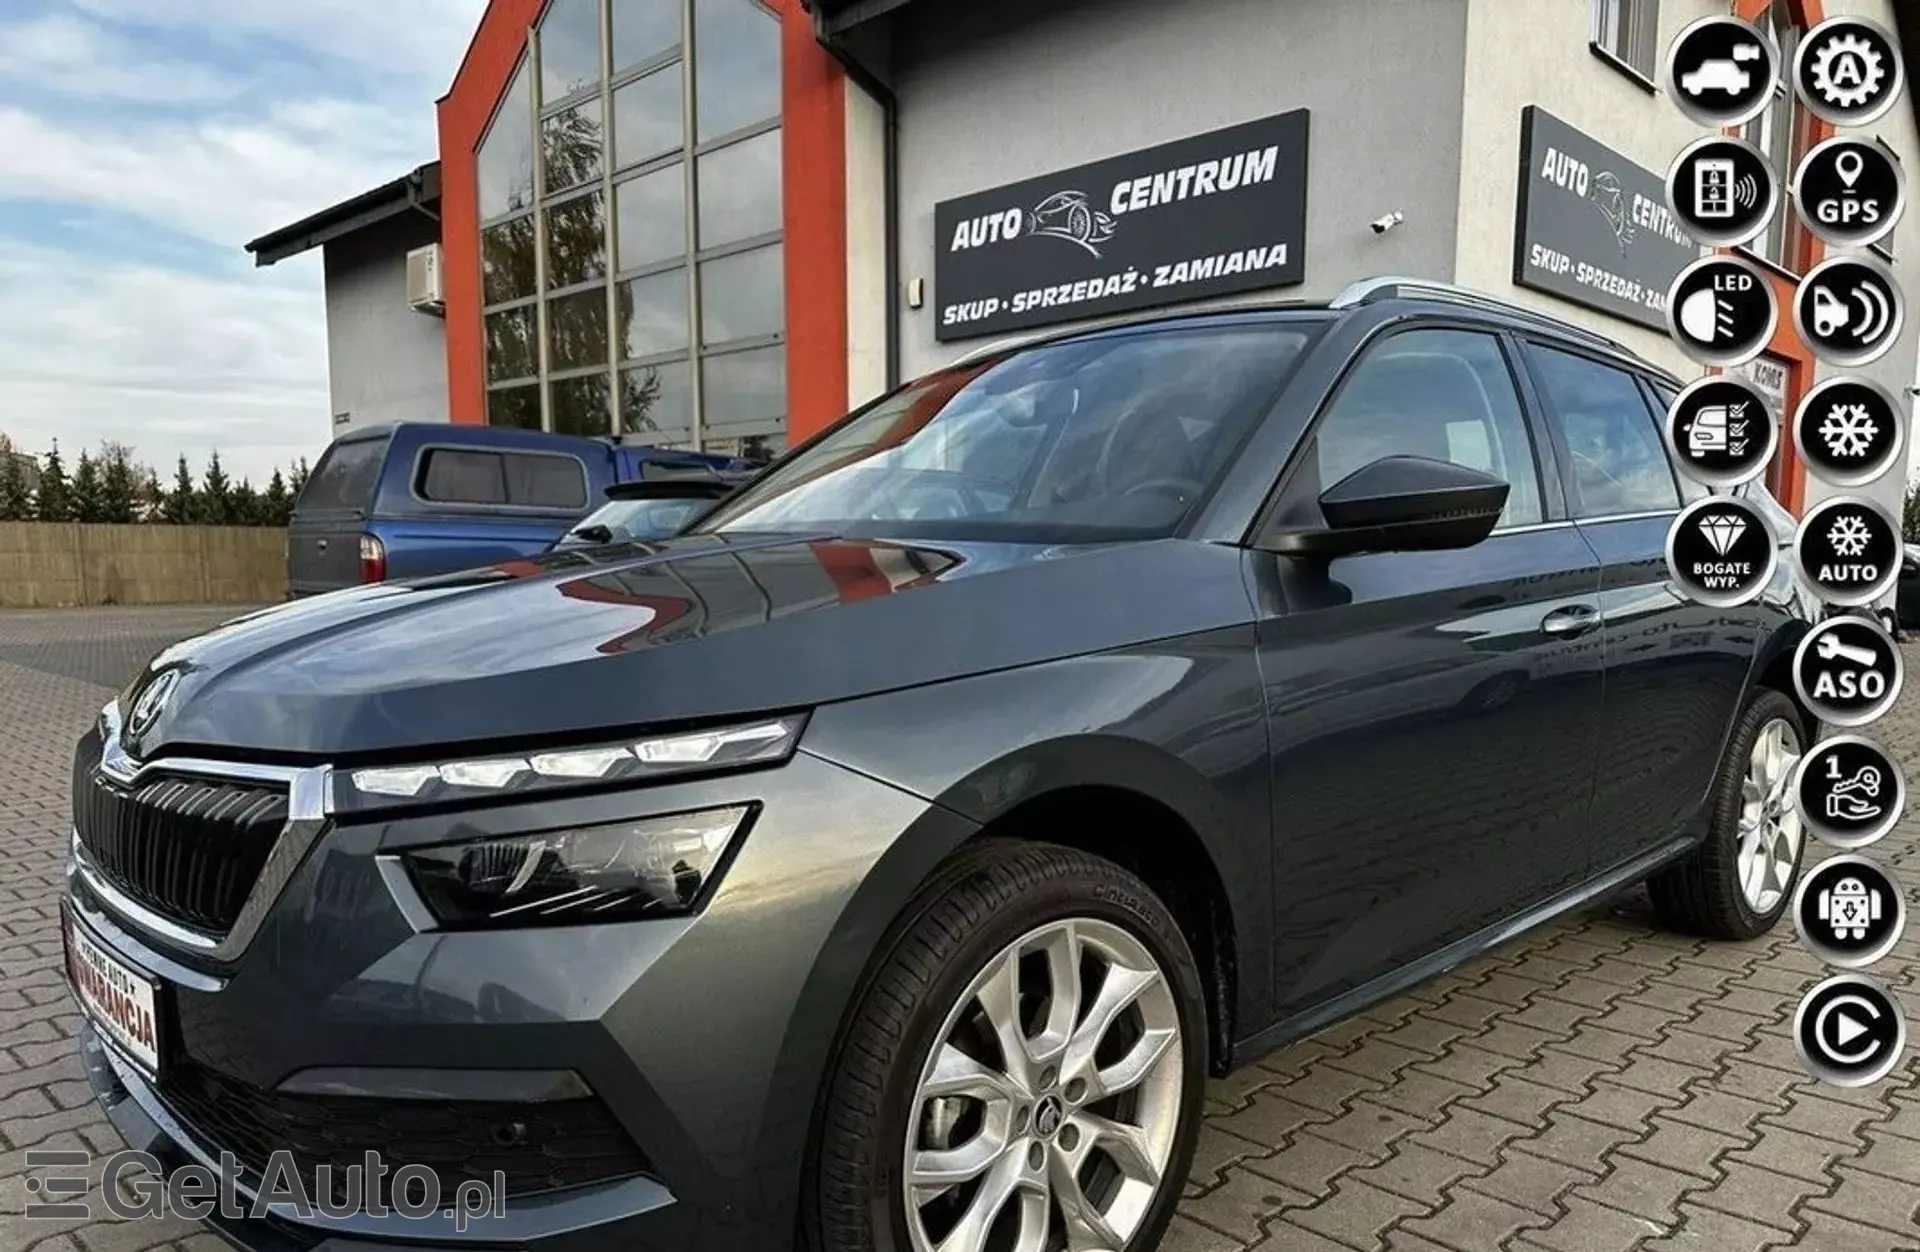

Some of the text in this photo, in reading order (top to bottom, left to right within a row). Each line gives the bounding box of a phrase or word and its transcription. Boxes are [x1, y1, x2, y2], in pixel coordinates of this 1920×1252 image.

[951, 146, 1278, 252] AUTO CENTRUM
[1541, 146, 1590, 199] AUTO
[943, 243, 1287, 326] SKUP SPRZEDAŻ ZAMIANA
[1530, 243, 1570, 276] SKUP
